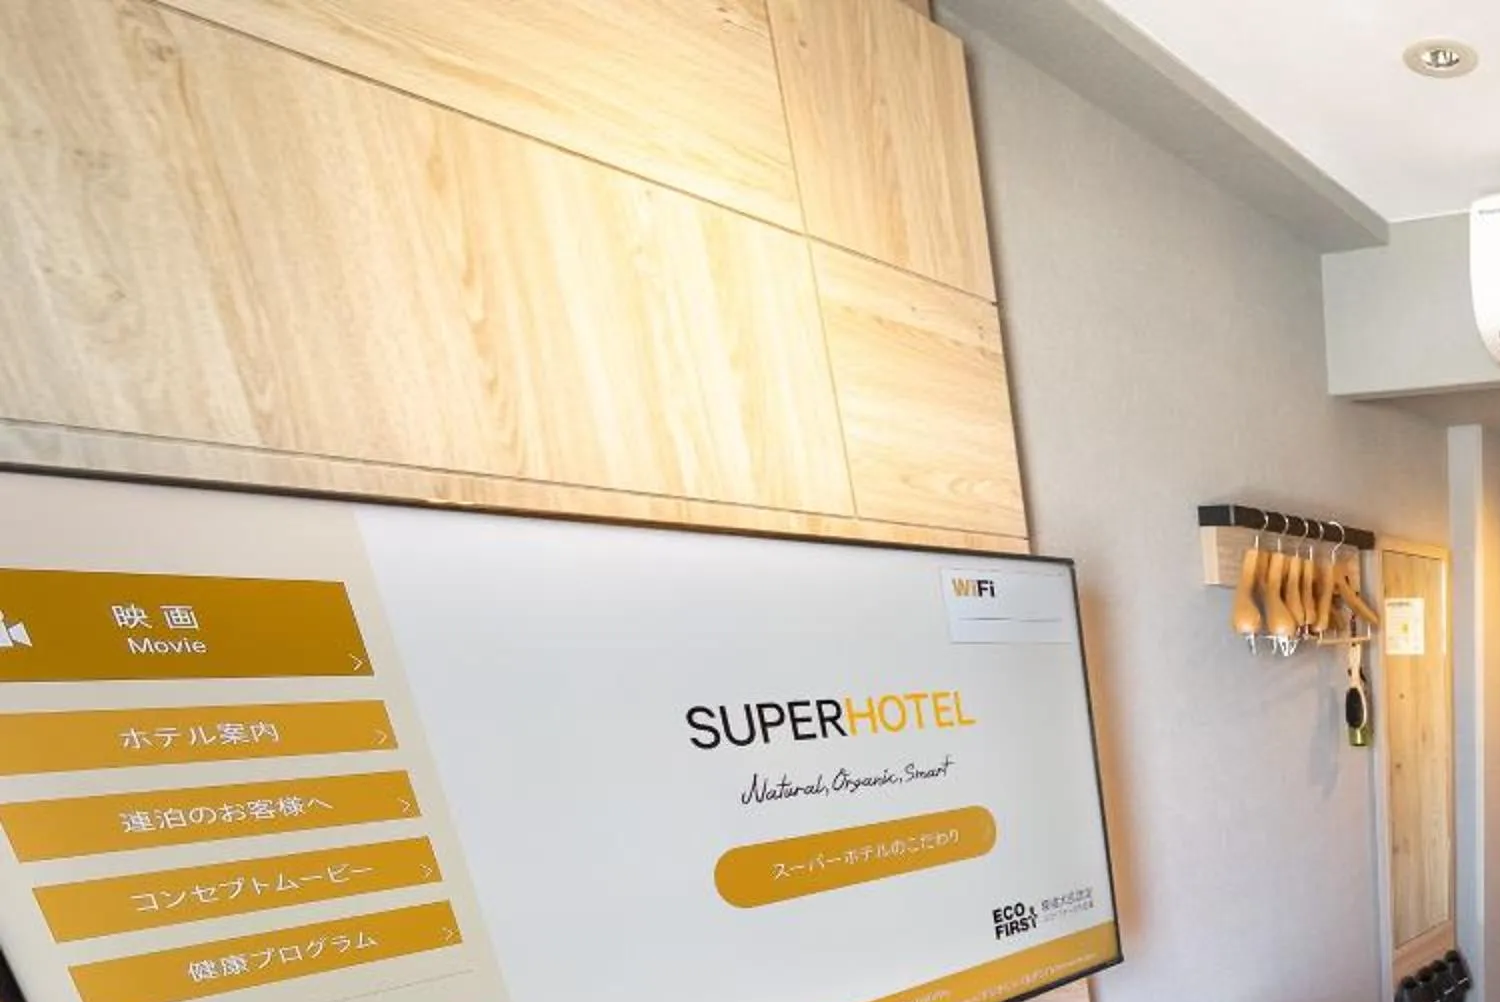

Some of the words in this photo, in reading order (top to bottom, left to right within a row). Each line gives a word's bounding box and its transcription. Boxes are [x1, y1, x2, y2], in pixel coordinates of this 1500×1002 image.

[952, 579, 995, 597] WiFi
[112, 604, 200, 631] 映画
[127, 637, 206, 655] Movie
[686, 691, 976, 749] SUPERHOTEL
[119, 720, 280, 750] ホテル案内
[905, 755, 955, 783] Smart
[120, 795, 334, 834] 連泊のお客様へ
[772, 829, 959, 879] スーパーホテルのこだわり
[130, 863, 374, 913] コンセプトムービー
[992, 903, 1026, 924] ECO
[995, 916, 1038, 940] FIRST
[187, 931, 378, 983] 健康プログラム
